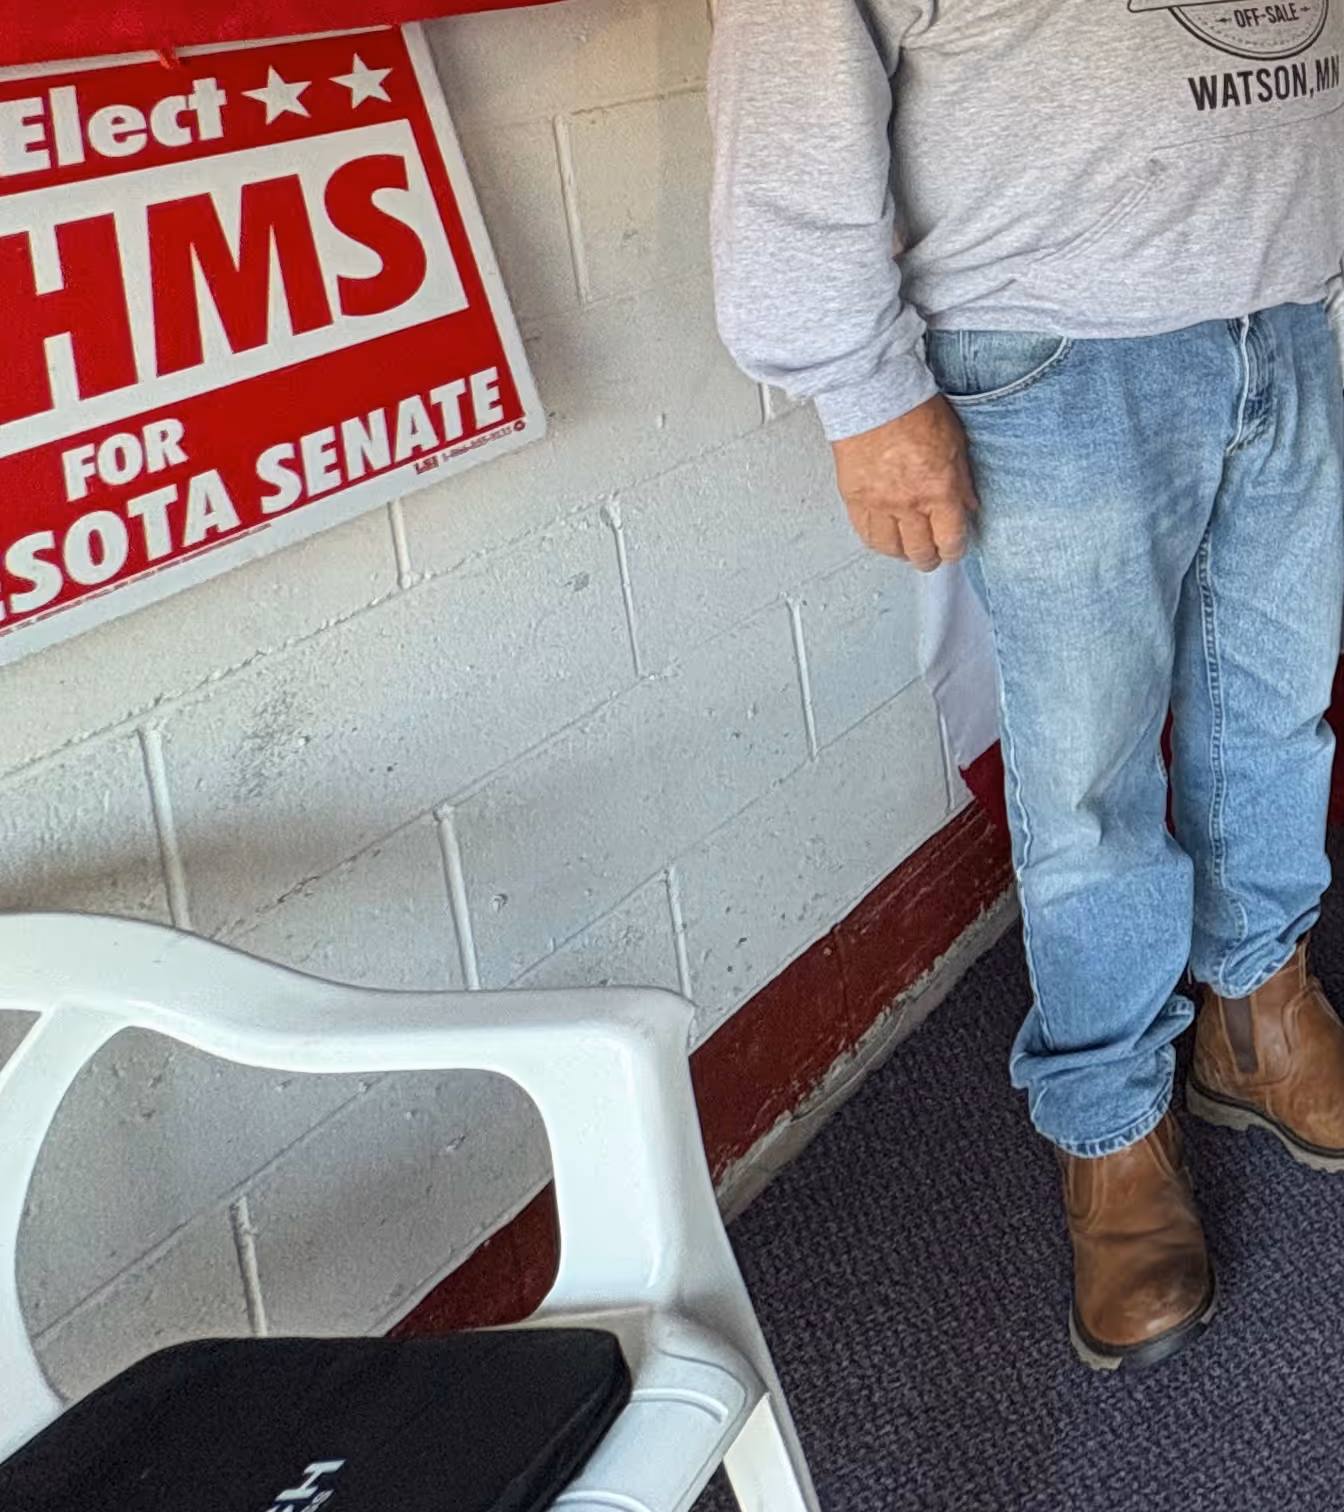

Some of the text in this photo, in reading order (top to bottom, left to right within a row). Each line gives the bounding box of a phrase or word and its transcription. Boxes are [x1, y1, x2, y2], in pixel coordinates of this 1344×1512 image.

[1233, 2, 1299, 28] OFF-SALE
[0, 365, 504, 624] SOTA SENATE
[62, 417, 190, 503] FOR
